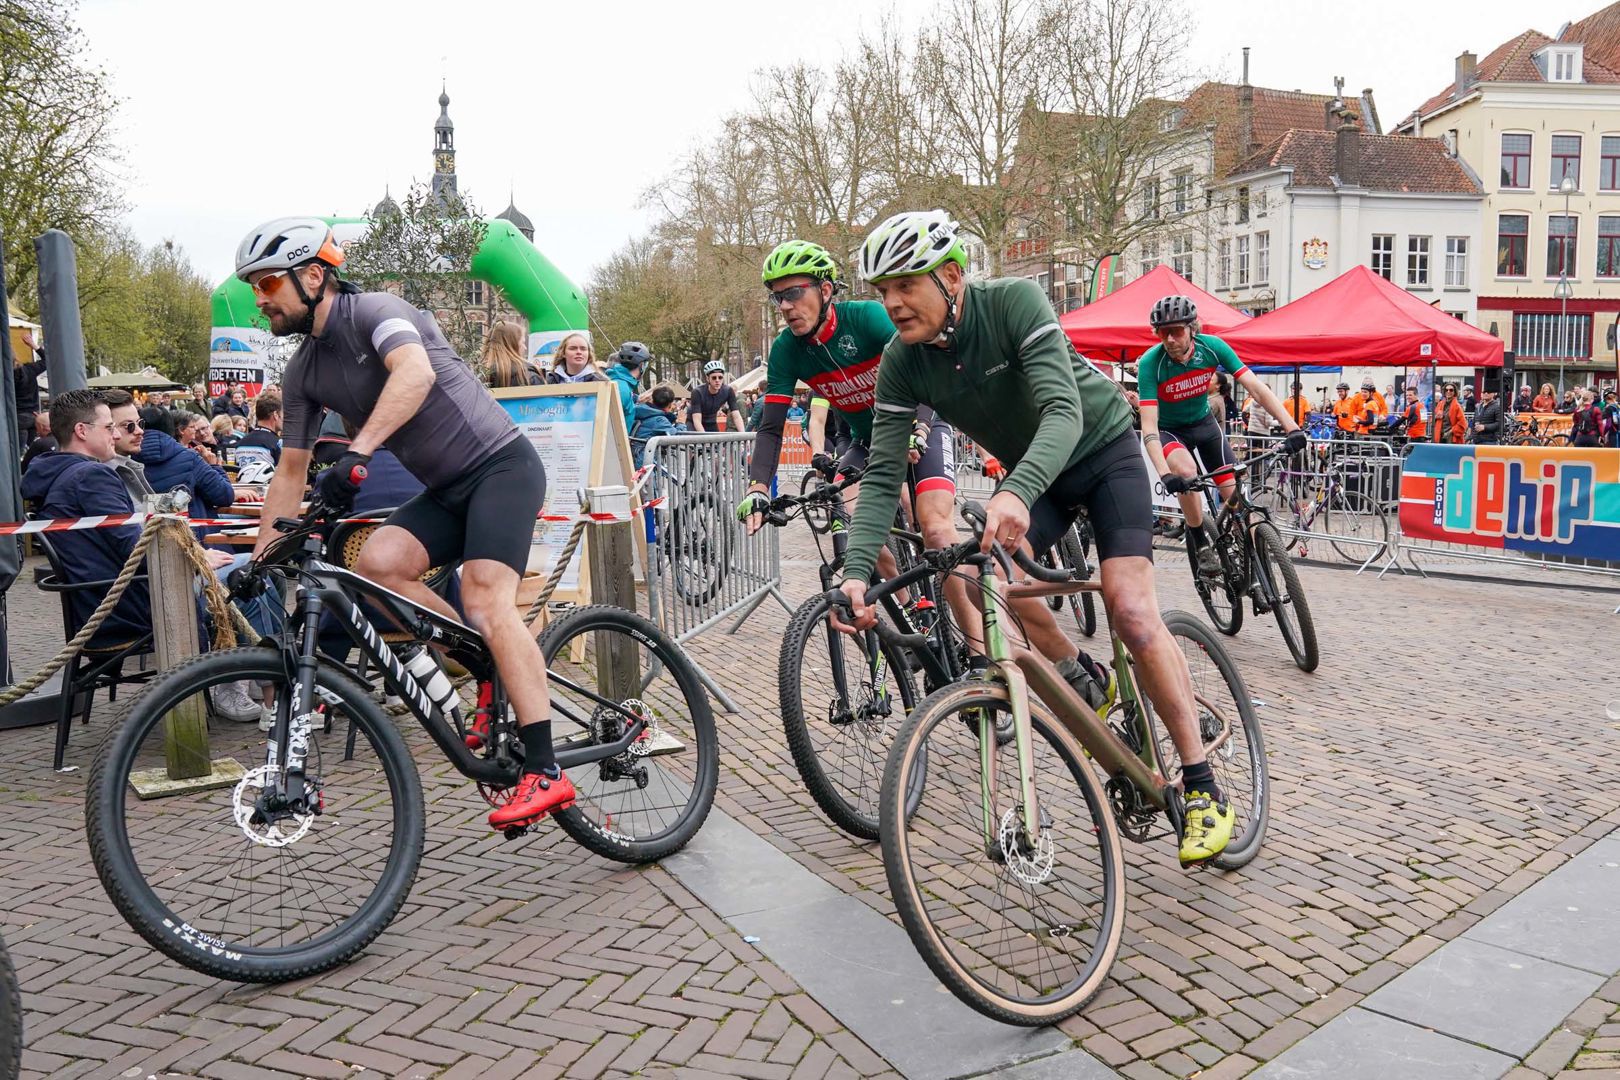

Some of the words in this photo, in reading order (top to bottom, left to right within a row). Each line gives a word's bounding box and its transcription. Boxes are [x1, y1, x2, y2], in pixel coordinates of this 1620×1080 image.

[286, 245, 310, 261] POC
[1165, 384, 1175, 393] DE
[1175, 371, 1213, 392] ZWALUWEN
[1173, 385, 1207, 400] DEVENTER
[836, 390, 876, 406] DEVENT
[1434, 480, 1444, 525] PODIUM
[351, 602, 432, 719] CANYON
[287, 727, 310, 768] FOX
[162, 918, 242, 961] MAXXIS
[181, 922, 198, 935] DT
[197, 933, 226, 949] SWISS
